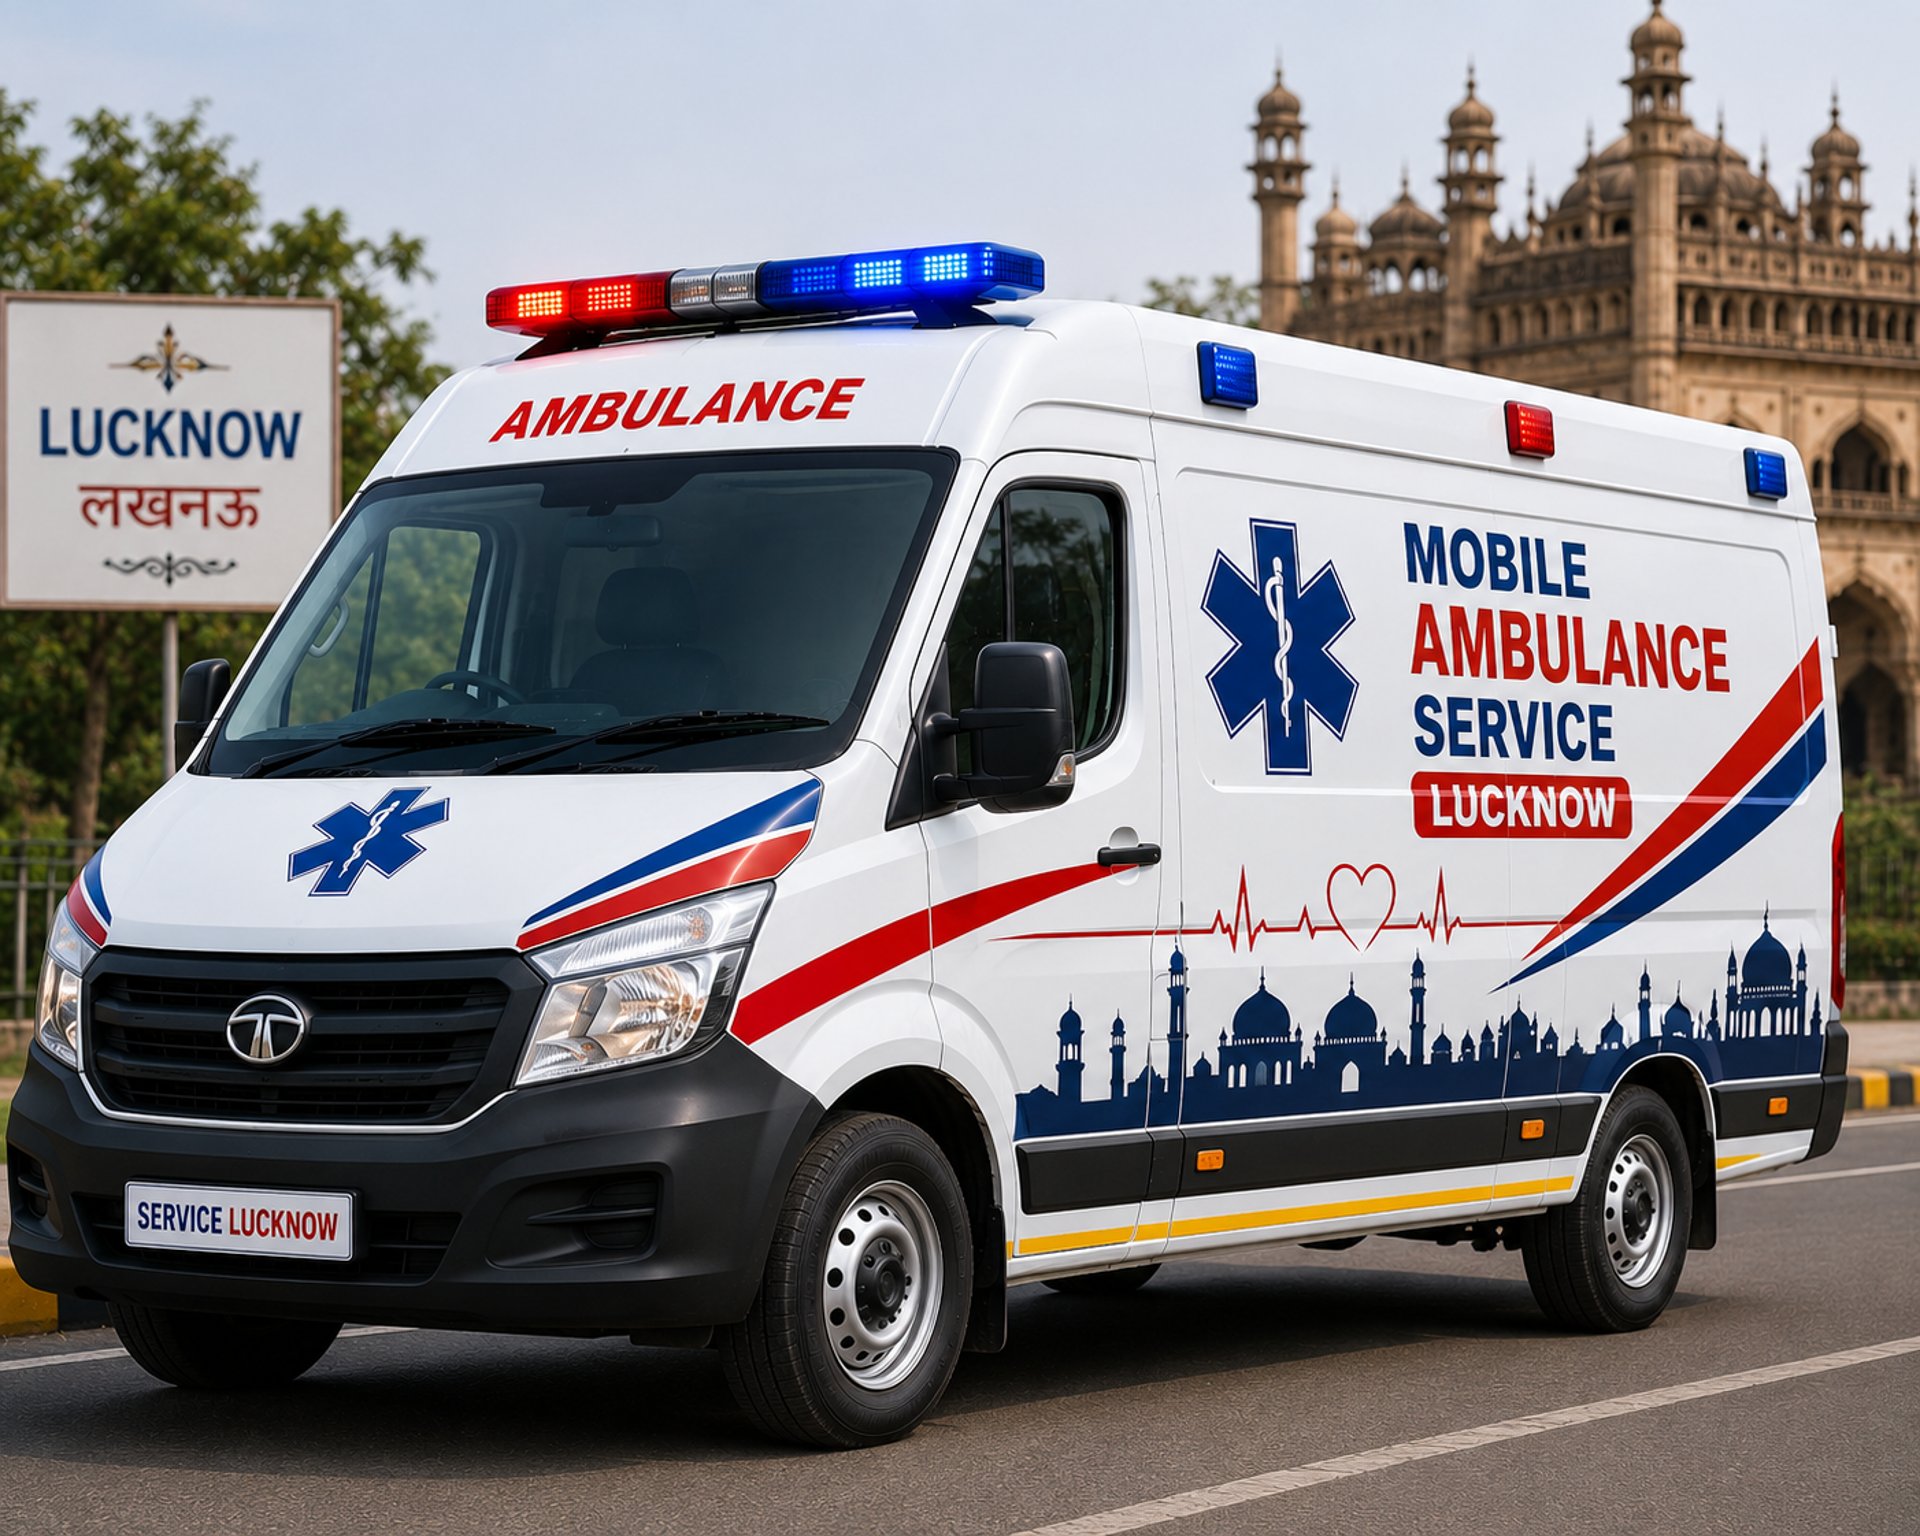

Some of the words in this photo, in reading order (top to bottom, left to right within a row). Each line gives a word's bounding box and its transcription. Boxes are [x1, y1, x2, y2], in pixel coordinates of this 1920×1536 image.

[40, 408, 302, 459] LUCKNOW
[489, 377, 865, 443] AMBULANCE
[79, 485, 261, 529] लखनऊ
[1403, 522, 1590, 599] MOBILE
[1410, 602, 1731, 693] AMBULANCE
[1413, 694, 1616, 762] SERVICE
[1430, 783, 1616, 828] LUCKNOW
[137, 1201, 223, 1235] SERVICE
[229, 1207, 338, 1241] LUCKNOW
